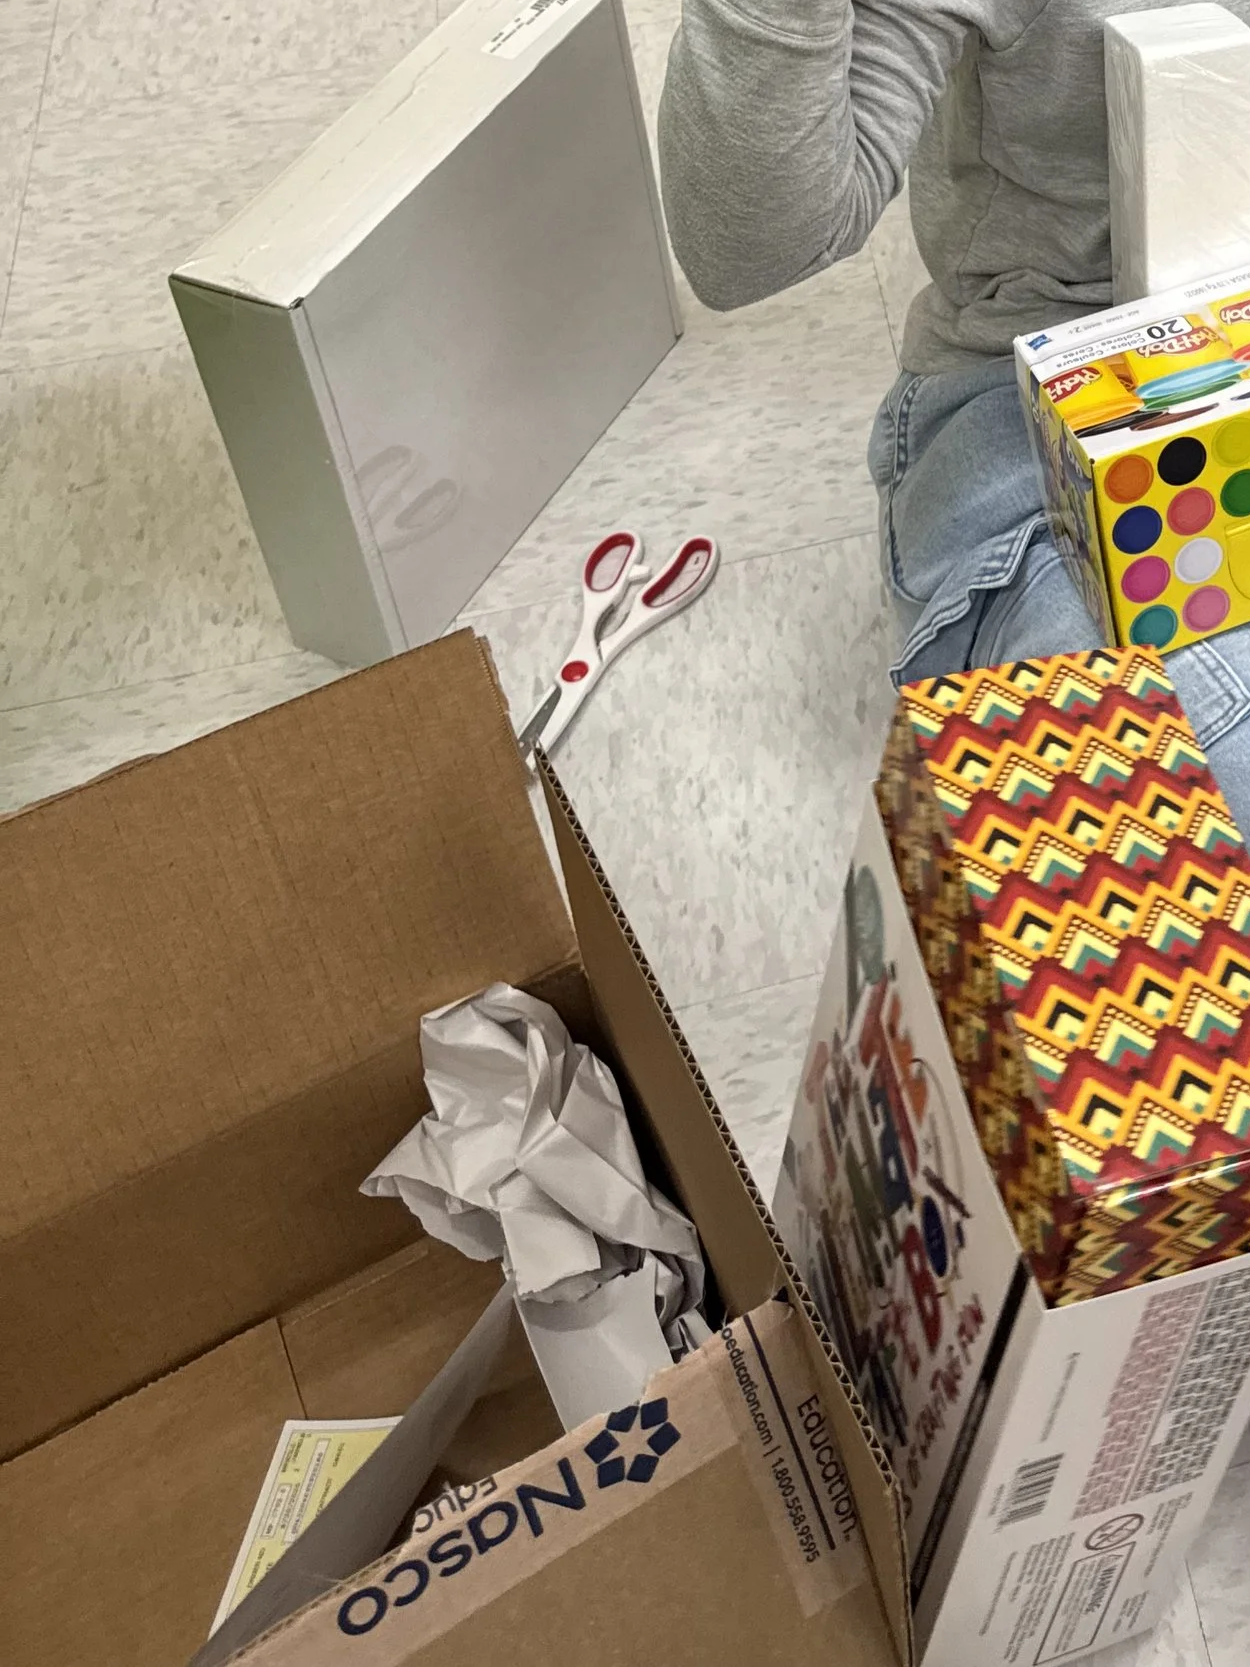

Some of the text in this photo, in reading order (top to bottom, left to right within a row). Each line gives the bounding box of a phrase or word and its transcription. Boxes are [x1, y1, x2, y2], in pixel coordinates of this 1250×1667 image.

[1111, 337, 1146, 350] Colors
[1147, 319, 1185, 340] 20
[771, 1457, 820, 1564] 1.800.558.9595
[336, 1458, 586, 1636] Nasco
